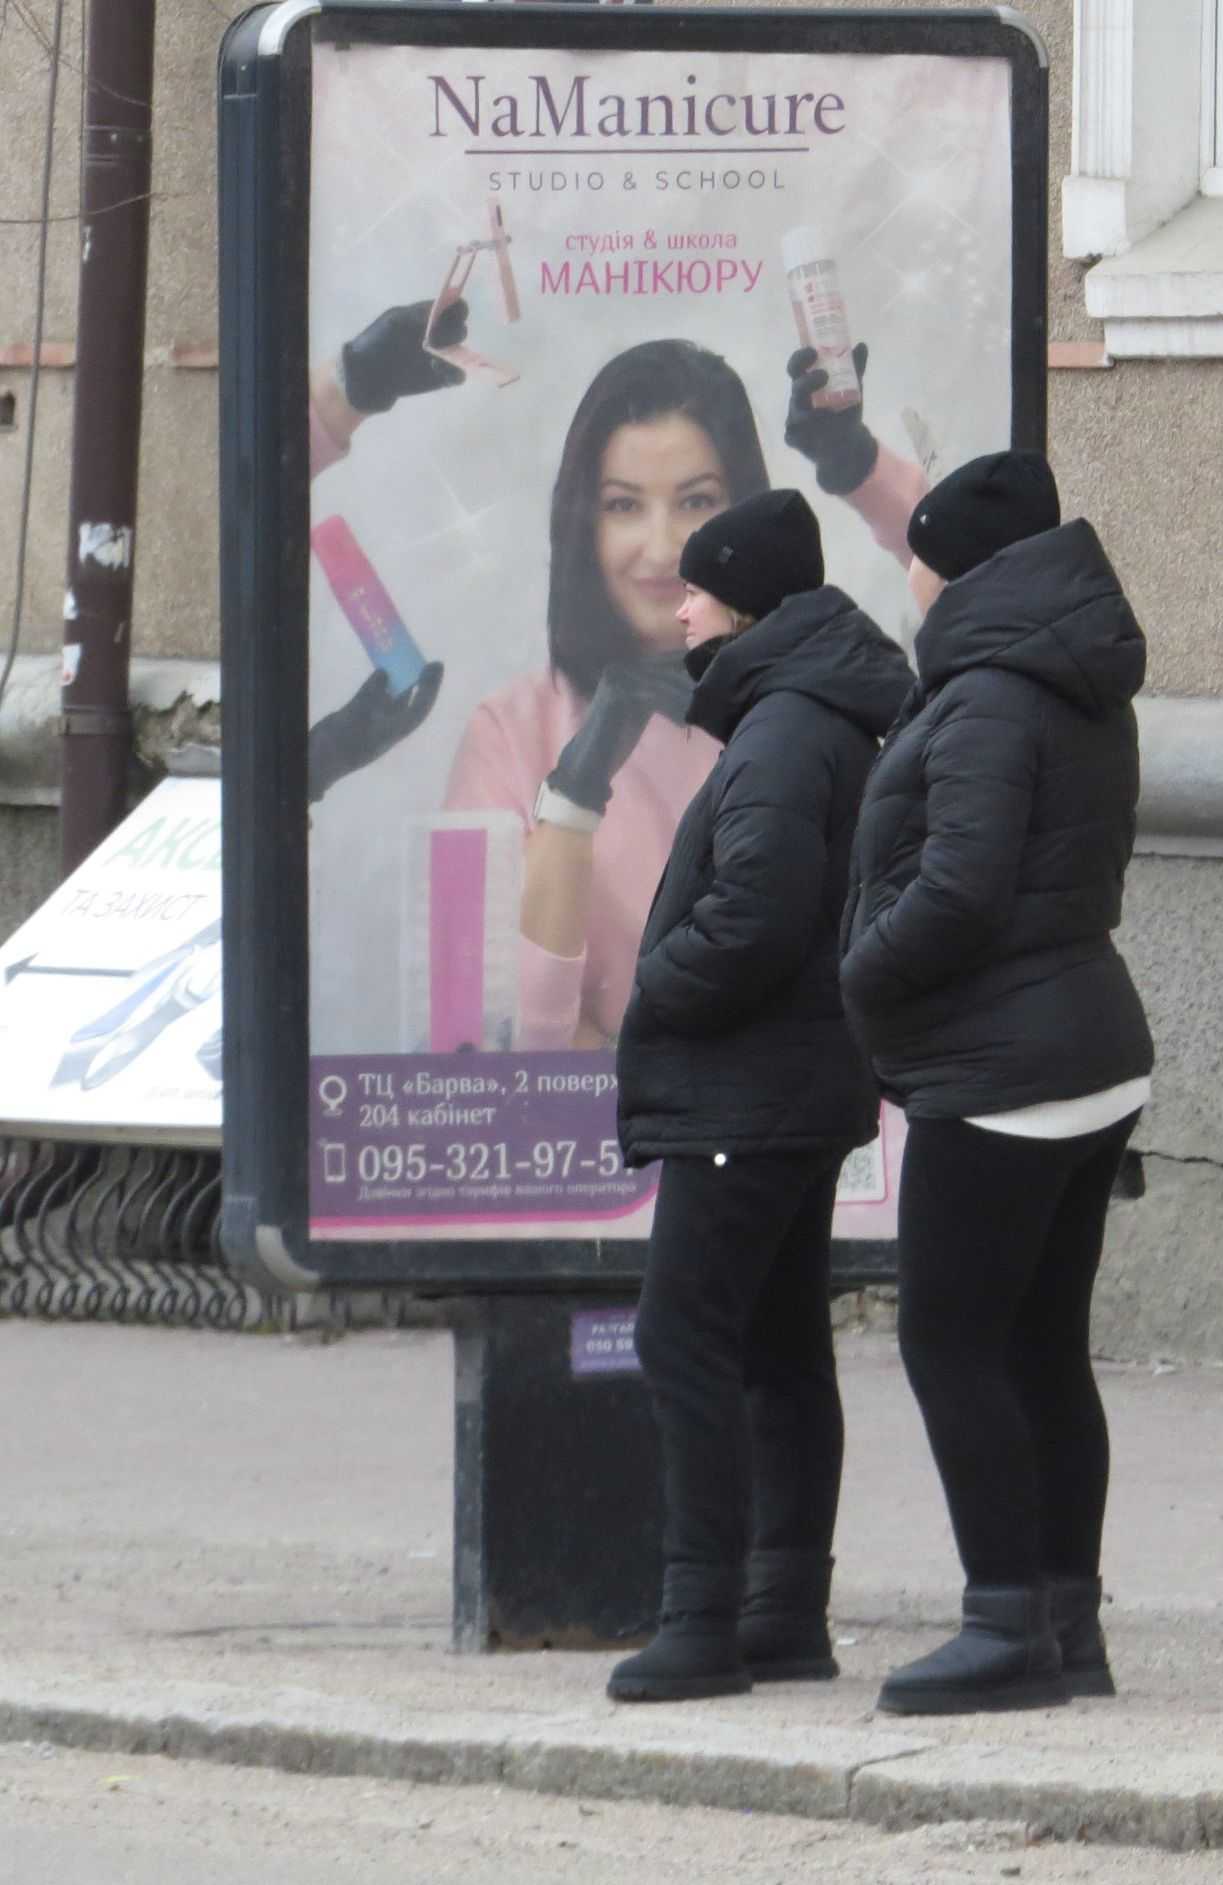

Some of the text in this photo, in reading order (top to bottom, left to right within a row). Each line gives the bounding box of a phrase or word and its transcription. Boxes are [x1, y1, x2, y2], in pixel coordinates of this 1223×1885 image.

[428, 75, 846, 137] NaManicure
[489, 169, 785, 191] STUDIO & SCHOOL
[565, 229, 737, 255] студія & школа
[541, 259, 763, 295] МАНІКЮРУ
[103, 815, 222, 870] АКС
[358, 1073, 394, 1100] ТЦ
[402, 1071, 506, 1100] «Барва»,
[514, 1069, 529, 1093] 2
[359, 1101, 497, 1128] 204 кабінет
[358, 1138, 634, 1181] 095-321-97-5
